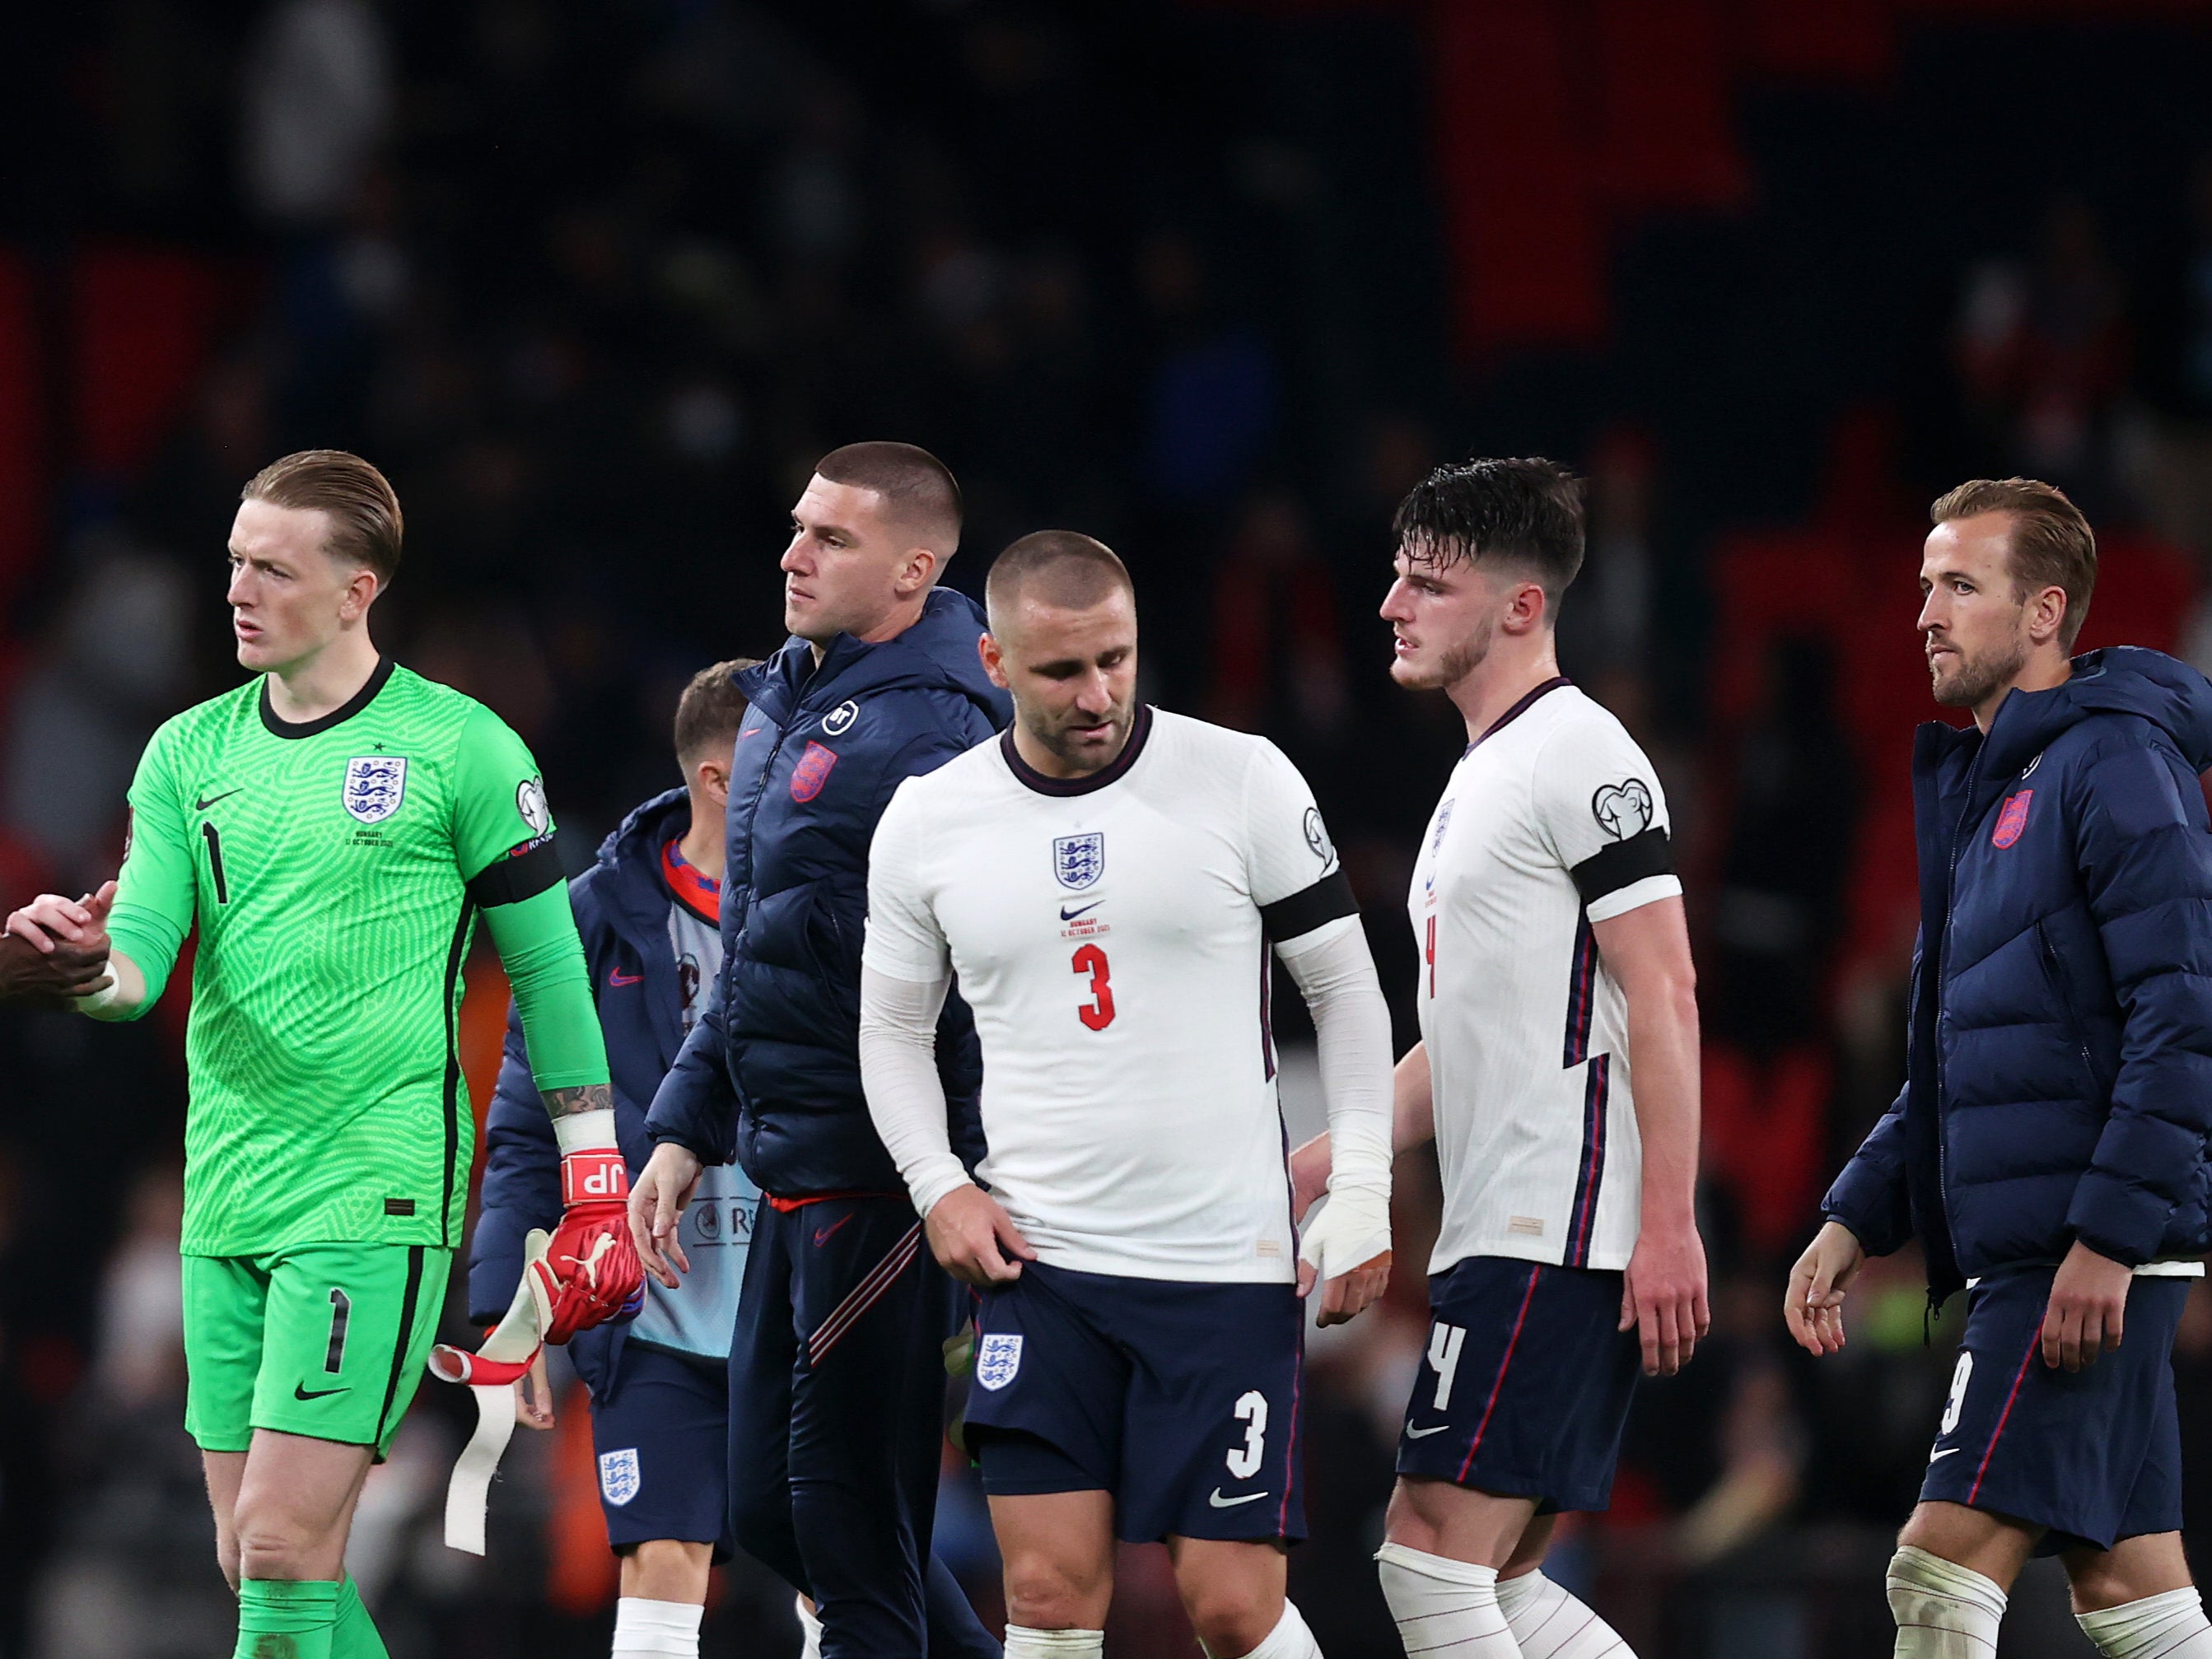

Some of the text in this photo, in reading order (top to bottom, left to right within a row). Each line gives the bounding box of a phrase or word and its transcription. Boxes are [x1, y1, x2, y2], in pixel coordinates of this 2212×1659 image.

[829, 707, 851, 725] BT
[203, 821, 227, 904] 1
[1071, 944, 1116, 1032] 3
[1426, 914, 1436, 999] 4
[584, 1163, 624, 1194] JP
[324, 1288, 352, 1374] 1
[1427, 1321, 1468, 1411] 4
[1226, 1390, 1268, 1480] 3
[1941, 1351, 1974, 1435] 9
